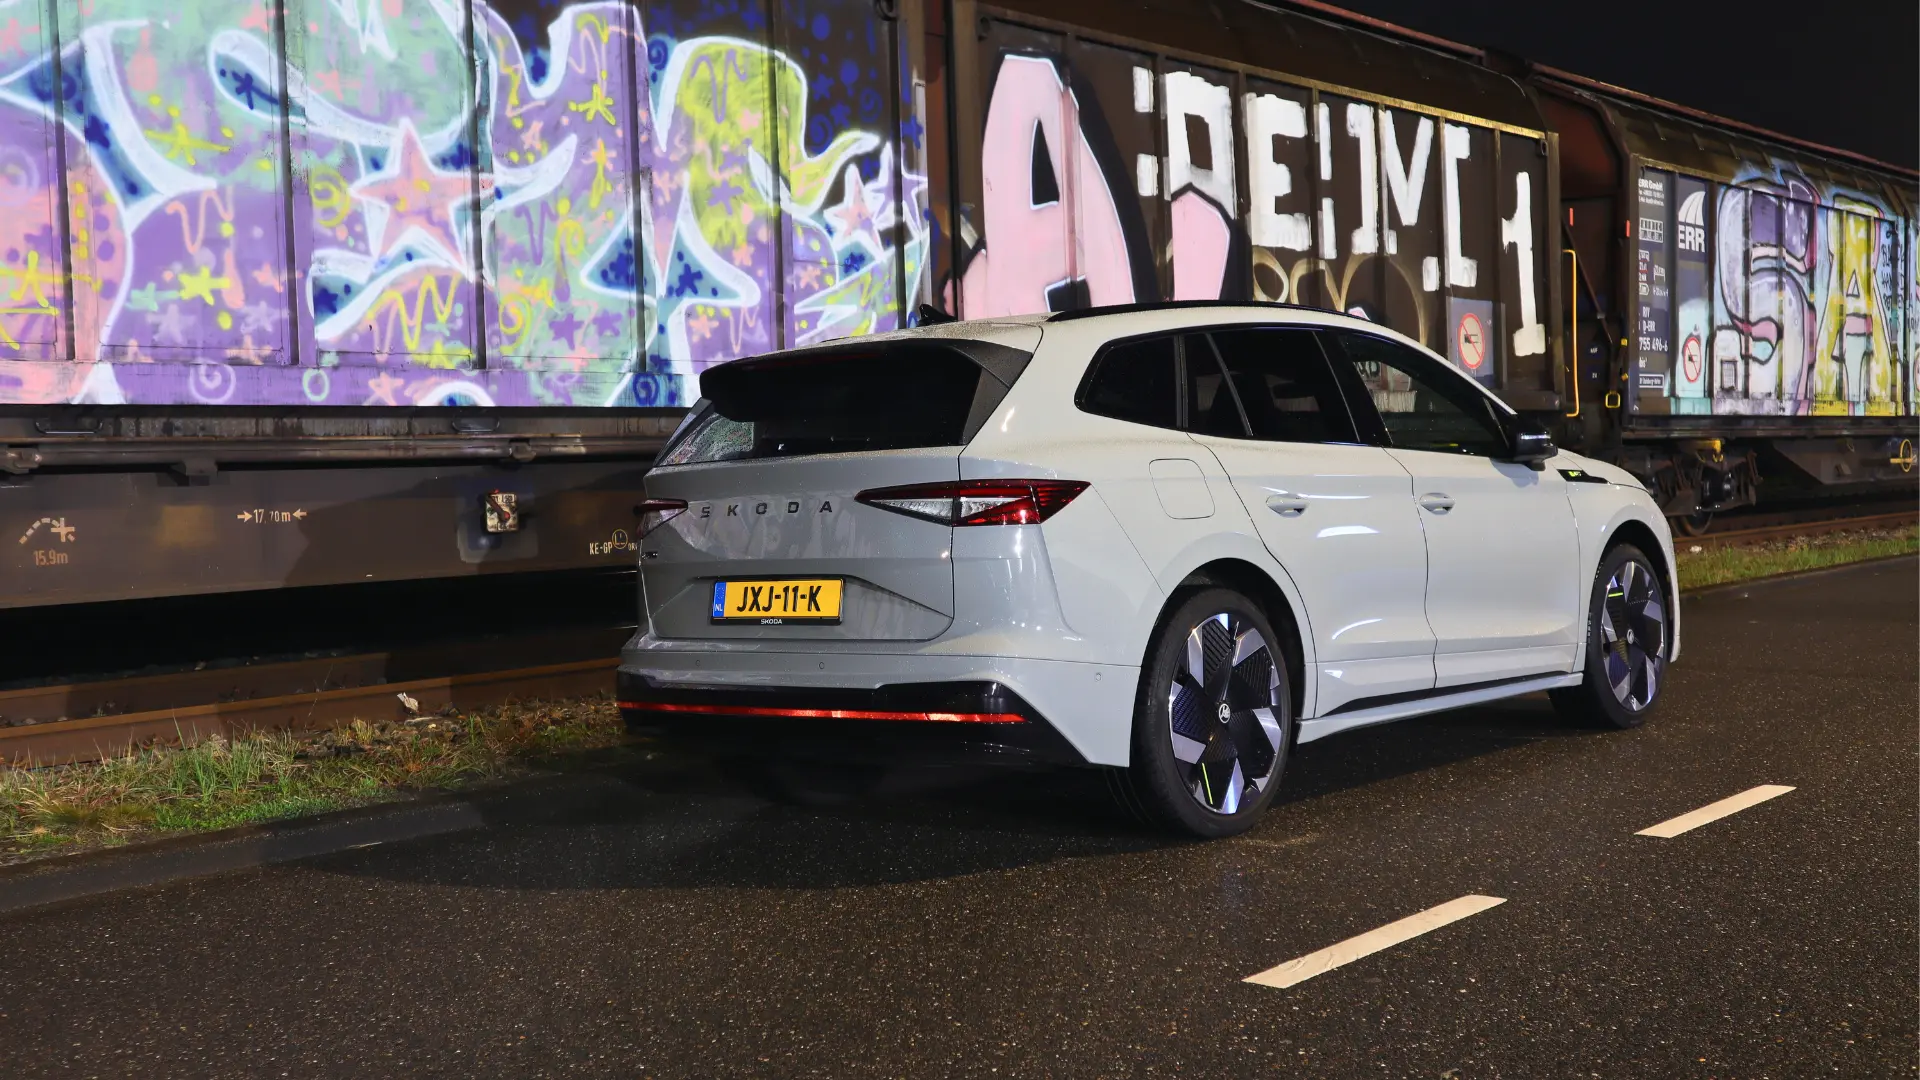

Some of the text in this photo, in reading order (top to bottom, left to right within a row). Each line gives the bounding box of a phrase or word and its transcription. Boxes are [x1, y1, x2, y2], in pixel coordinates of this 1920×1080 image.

[1678, 224, 1706, 253] ERR
[589, 541, 613, 555] KE-GP
[33, 550, 69, 566] 15.9m
[736, 585, 823, 613] JXJ-11-K
[714, 603, 724, 612] NL
